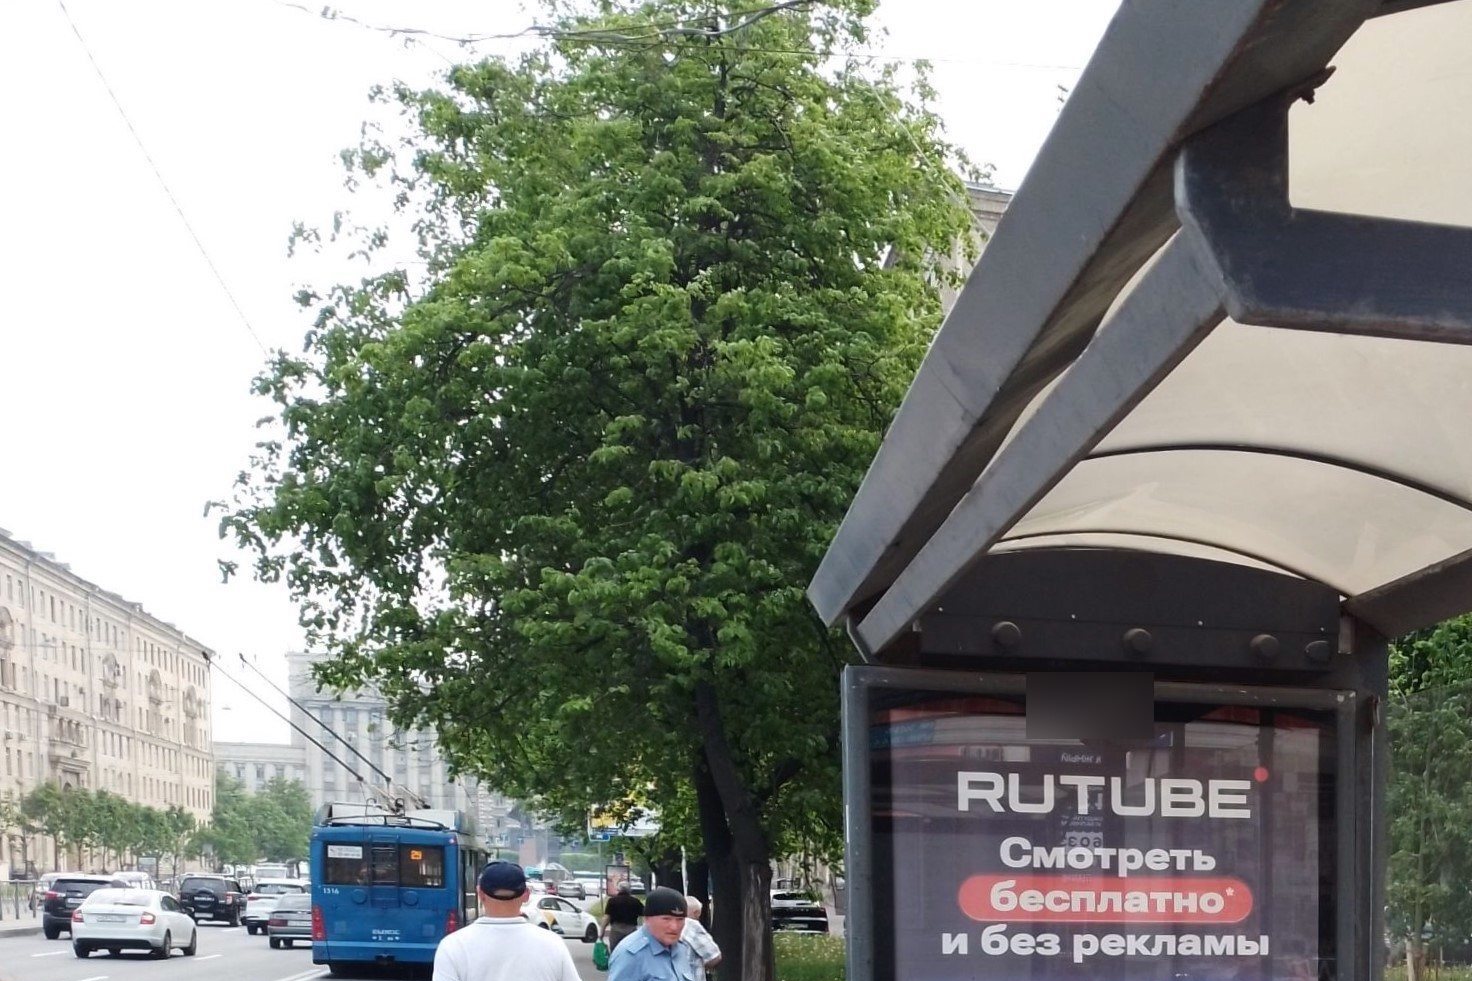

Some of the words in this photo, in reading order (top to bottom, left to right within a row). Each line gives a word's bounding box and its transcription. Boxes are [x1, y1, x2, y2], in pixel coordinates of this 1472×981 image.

[957, 771, 1251, 819] RUTUBE
[1000, 836, 1217, 877] Смотреть
[942, 932, 968, 955] и
[981, 924, 1060, 956] без
[1073, 934, 1269, 963] рекламы
